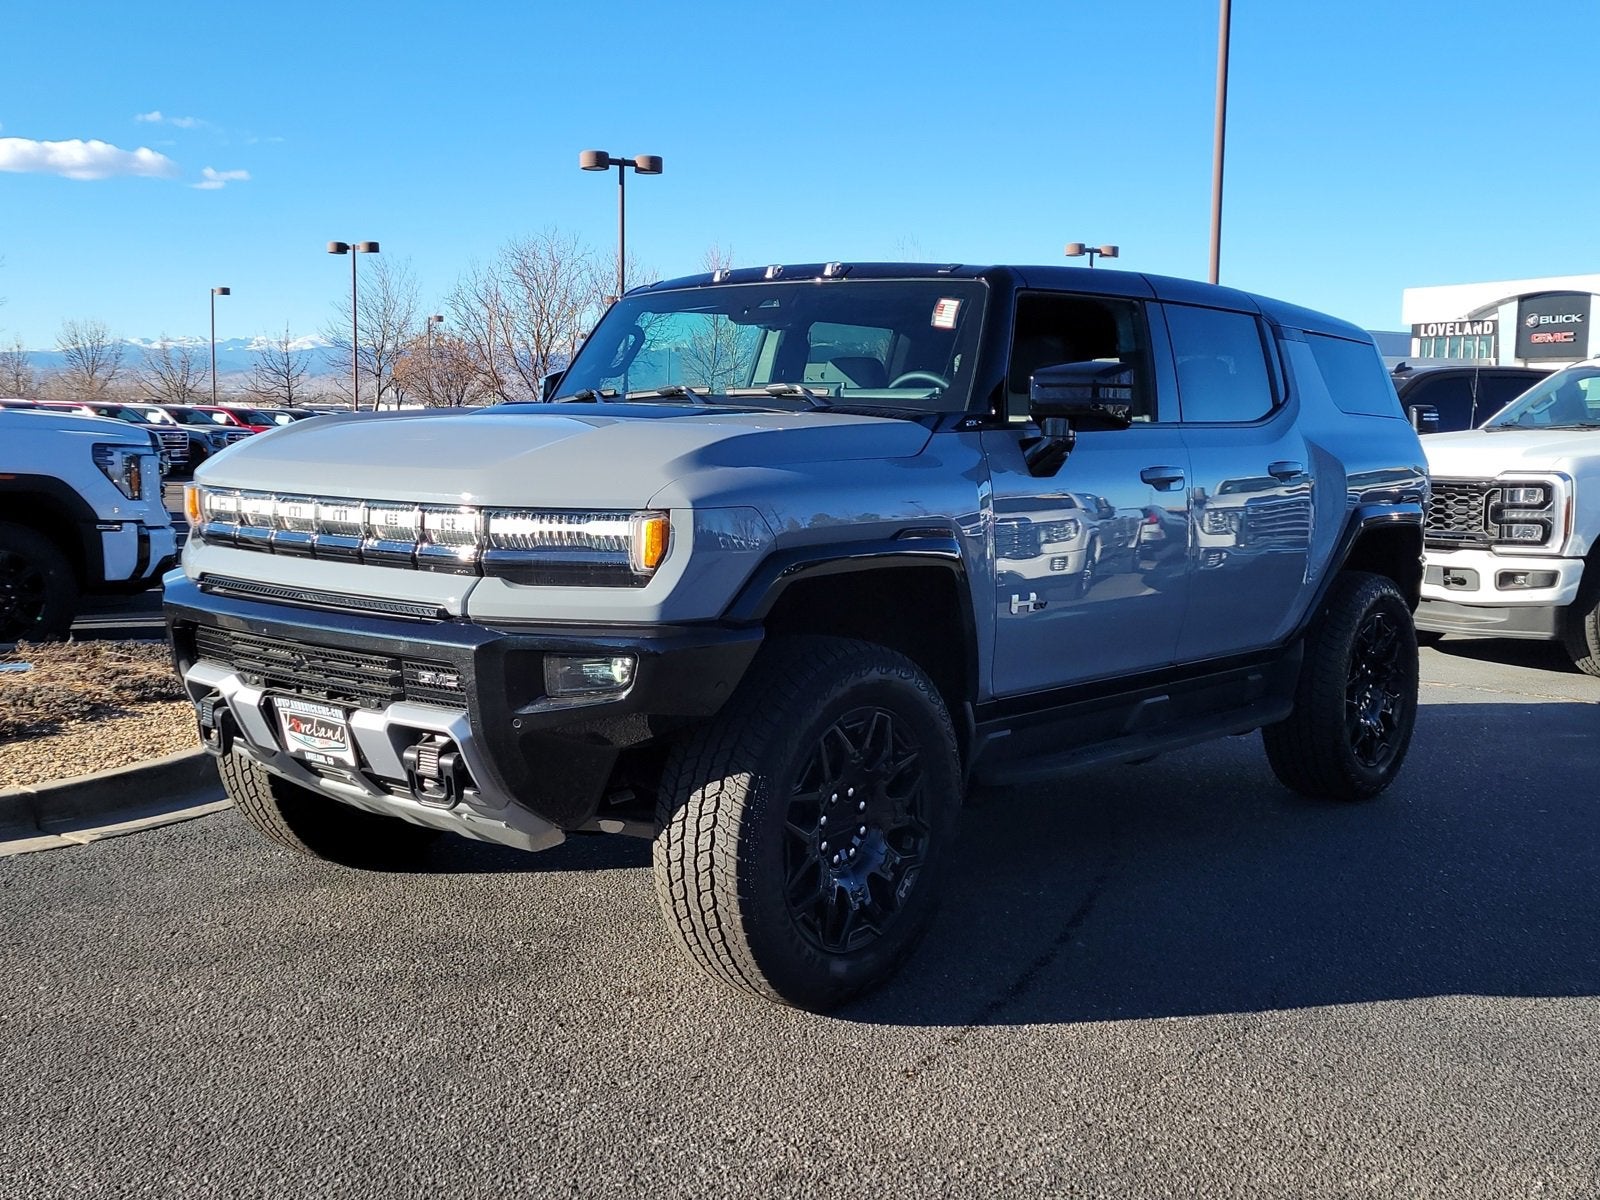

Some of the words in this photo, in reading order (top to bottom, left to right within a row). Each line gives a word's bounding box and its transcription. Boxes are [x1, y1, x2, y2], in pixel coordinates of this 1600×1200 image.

[1539, 314, 1584, 325] BUICK
[1420, 321, 1494, 337] LOVELAND
[1530, 331, 1576, 345] GMC
[418, 671, 460, 687] GMC
